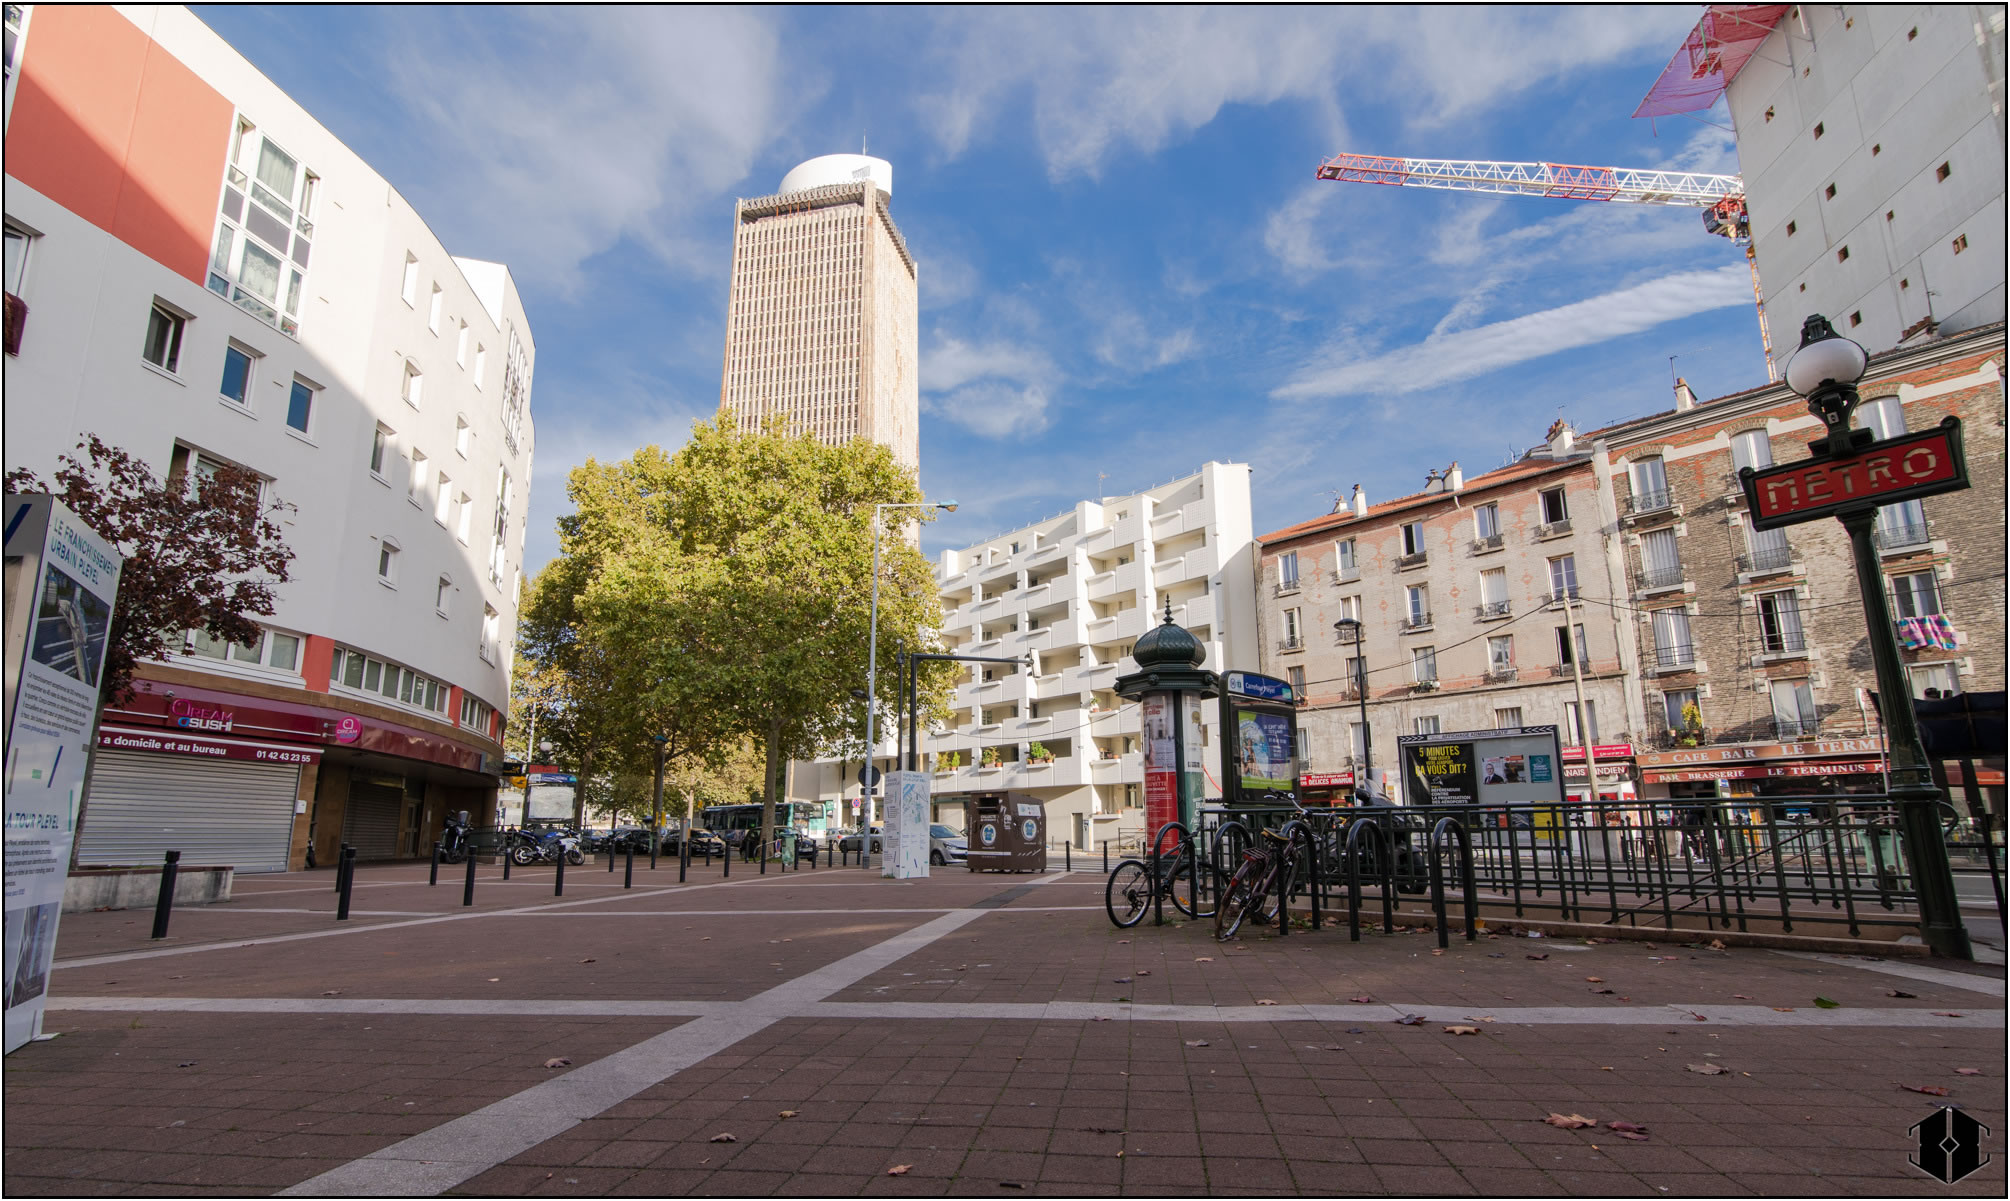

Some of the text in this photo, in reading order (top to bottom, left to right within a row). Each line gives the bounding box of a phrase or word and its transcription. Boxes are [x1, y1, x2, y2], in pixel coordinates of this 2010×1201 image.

[1766, 447, 1937, 510] METRO
[54, 517, 118, 577] LE FRANCHISSEMENT
[51, 536, 99, 585] URBAIN PLEYEL
[103, 735, 111, 745] a
[113, 736, 162, 749] domicile
[164, 741, 176, 750] et
[177, 743, 191, 752] au
[192, 743, 227, 756] bureau
[1418, 745, 1460, 757] 5 MINUTES
[1672, 740, 1877, 763] CAFE BAR LE TERM
[256, 750, 311, 763] 01 42 43 23 55
[1426, 764, 1448, 775] VOUS
[1688, 770, 1745, 780] BRASSERIE
[1767, 768, 1785, 776] LE
[1791, 763, 1866, 775] TERMINUS
[15, 812, 36, 828] TOUR
[37, 813, 59, 829] PLEYEL
